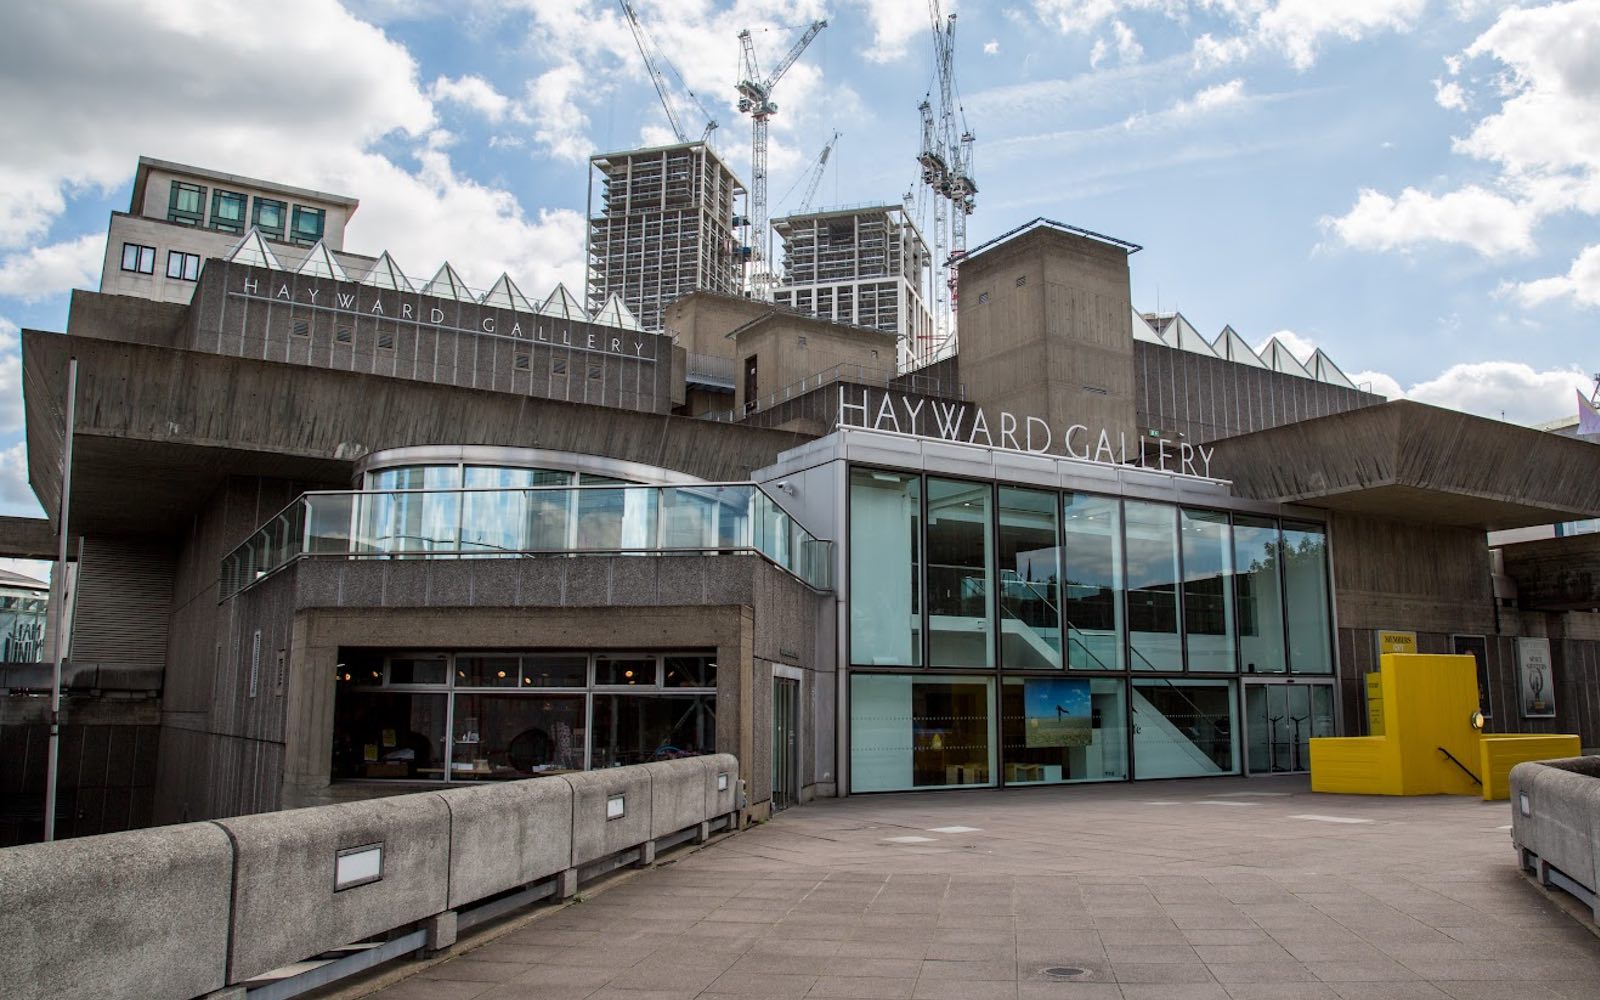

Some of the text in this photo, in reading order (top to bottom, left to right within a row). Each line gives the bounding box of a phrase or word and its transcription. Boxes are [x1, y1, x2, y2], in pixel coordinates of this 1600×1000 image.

[243, 277, 643, 356] HAYWARD GALLERY
[839, 385, 1215, 478] HAYWARD GALLERY
